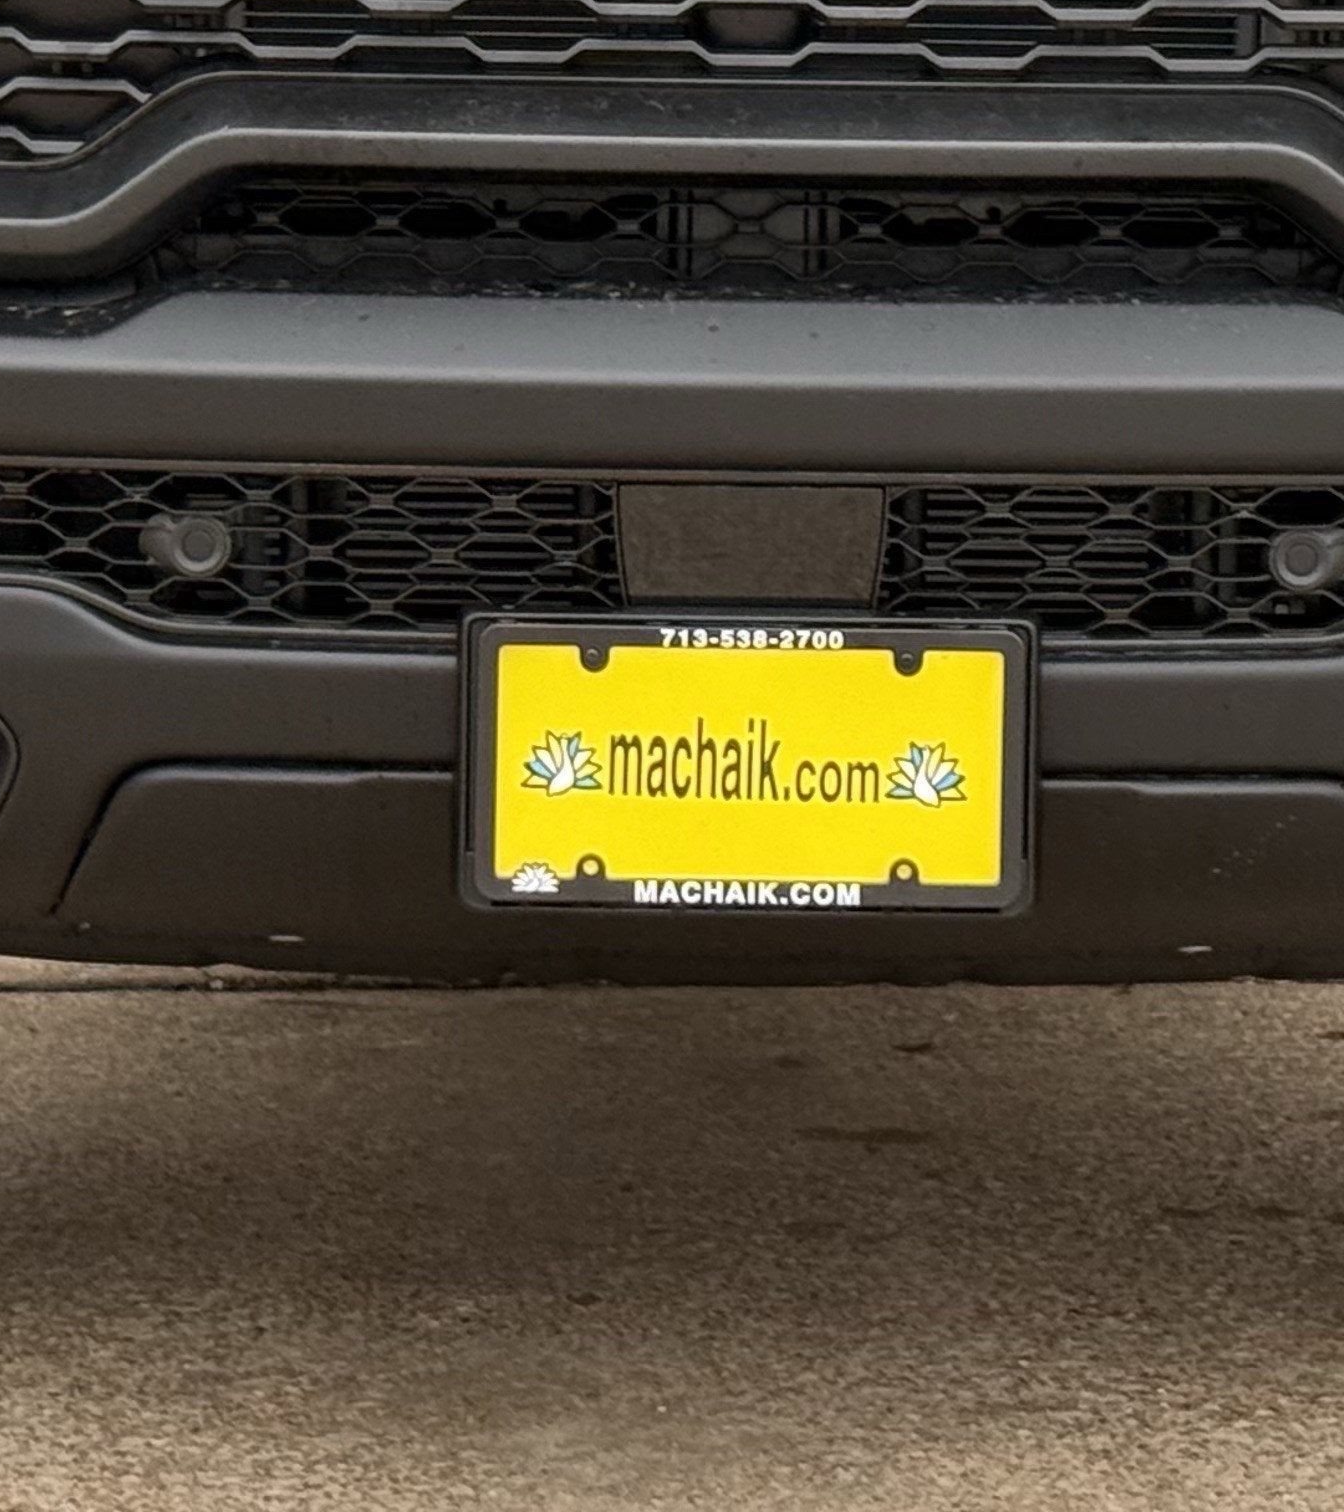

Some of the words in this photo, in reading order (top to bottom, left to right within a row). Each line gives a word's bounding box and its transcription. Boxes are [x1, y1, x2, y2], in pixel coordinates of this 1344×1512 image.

[660, 628, 845, 650] 713-538-2700
[608, 717, 881, 803] machaik.com
[633, 882, 862, 906] MACHAIK.COM
